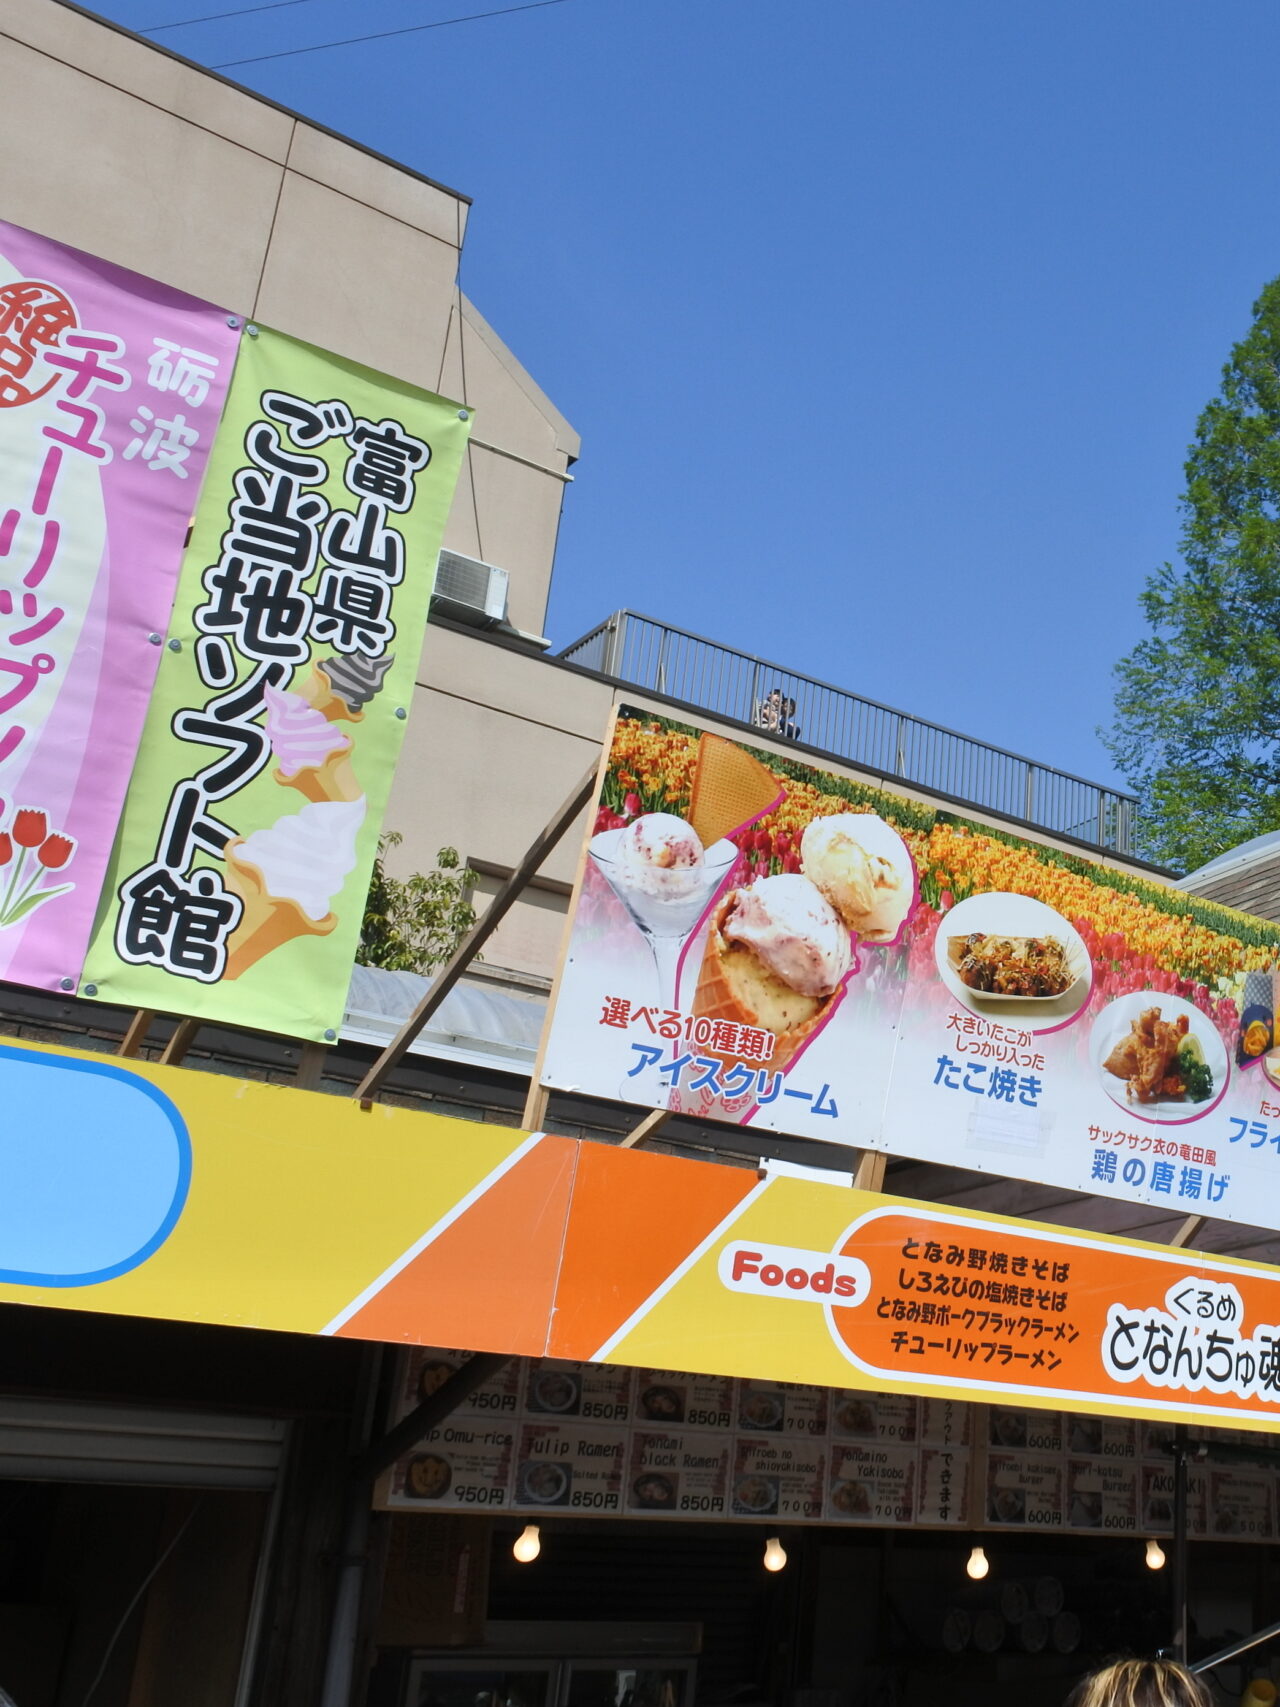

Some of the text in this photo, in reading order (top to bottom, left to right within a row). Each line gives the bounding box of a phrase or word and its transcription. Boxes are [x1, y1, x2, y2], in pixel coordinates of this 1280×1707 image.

[123, 337, 219, 479] 砺波
[314, 420, 431, 654] 富山県
[120, 391, 352, 983] ご当地ソフト館
[599, 996, 774, 1060] 選べる10種類!
[946, 1013, 1032, 1047] 大きいたこが
[956, 1034, 1045, 1071] しっかり入った
[627, 1042, 839, 1119] アイスクリーム
[933, 1054, 1043, 1107] たこ焼き
[1088, 1124, 1217, 1167] サックサク衣の竜田風
[1091, 1148, 1231, 1202] 鶏の唐揚げ
[901, 1238, 1070, 1283] となみ野焼きそば
[732, 1250, 856, 1297] Foods
[898, 1268, 1068, 1313] しろえびの塩焼きそば
[1173, 1288, 1236, 1322] くるめ
[890, 1331, 1062, 1371] チューリップラーメン
[468, 1392, 516, 1411] 950円
[582, 1402, 629, 1420] 850円
[688, 1409, 731, 1427] 850円
[444, 1428, 513, 1446] Omu-rice
[527, 1437, 620, 1457] Tulip Ramen
[641, 1435, 684, 1450] Tonami
[1028, 1435, 1062, 1450] 600円
[1104, 1442, 1136, 1458] 600円
[683, 1454, 719, 1469] Ramen
[857, 1464, 905, 1479] Yakisoba
[454, 1485, 505, 1505] 950円
[939, 1453, 954, 1521] できます
[1102, 1479, 1132, 1492] Burger
[572, 1490, 619, 1509] 850円
[680, 1495, 725, 1512] 850円
[782, 1500, 822, 1515] 700円
[875, 1504, 913, 1519] 700円
[1028, 1509, 1062, 1525] 600円
[1104, 1515, 1136, 1529] 600円
